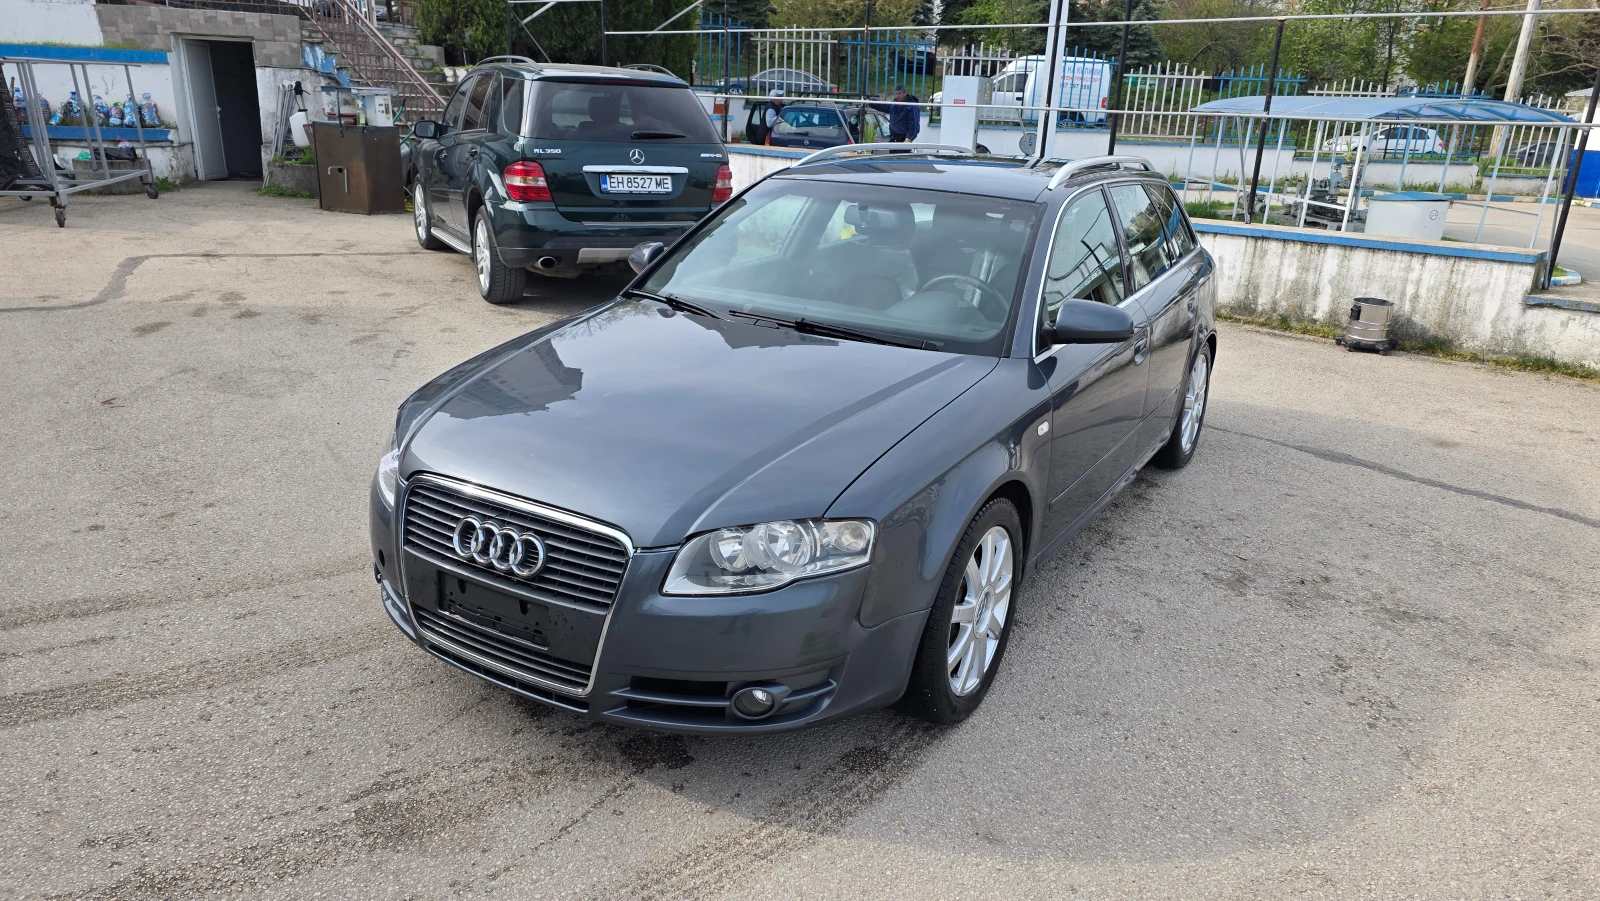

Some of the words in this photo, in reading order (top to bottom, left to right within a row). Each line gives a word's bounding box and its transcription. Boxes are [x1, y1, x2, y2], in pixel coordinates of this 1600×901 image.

[609, 175, 625, 189] EH
[626, 176, 653, 189] 8527
[655, 177, 670, 190] ME
